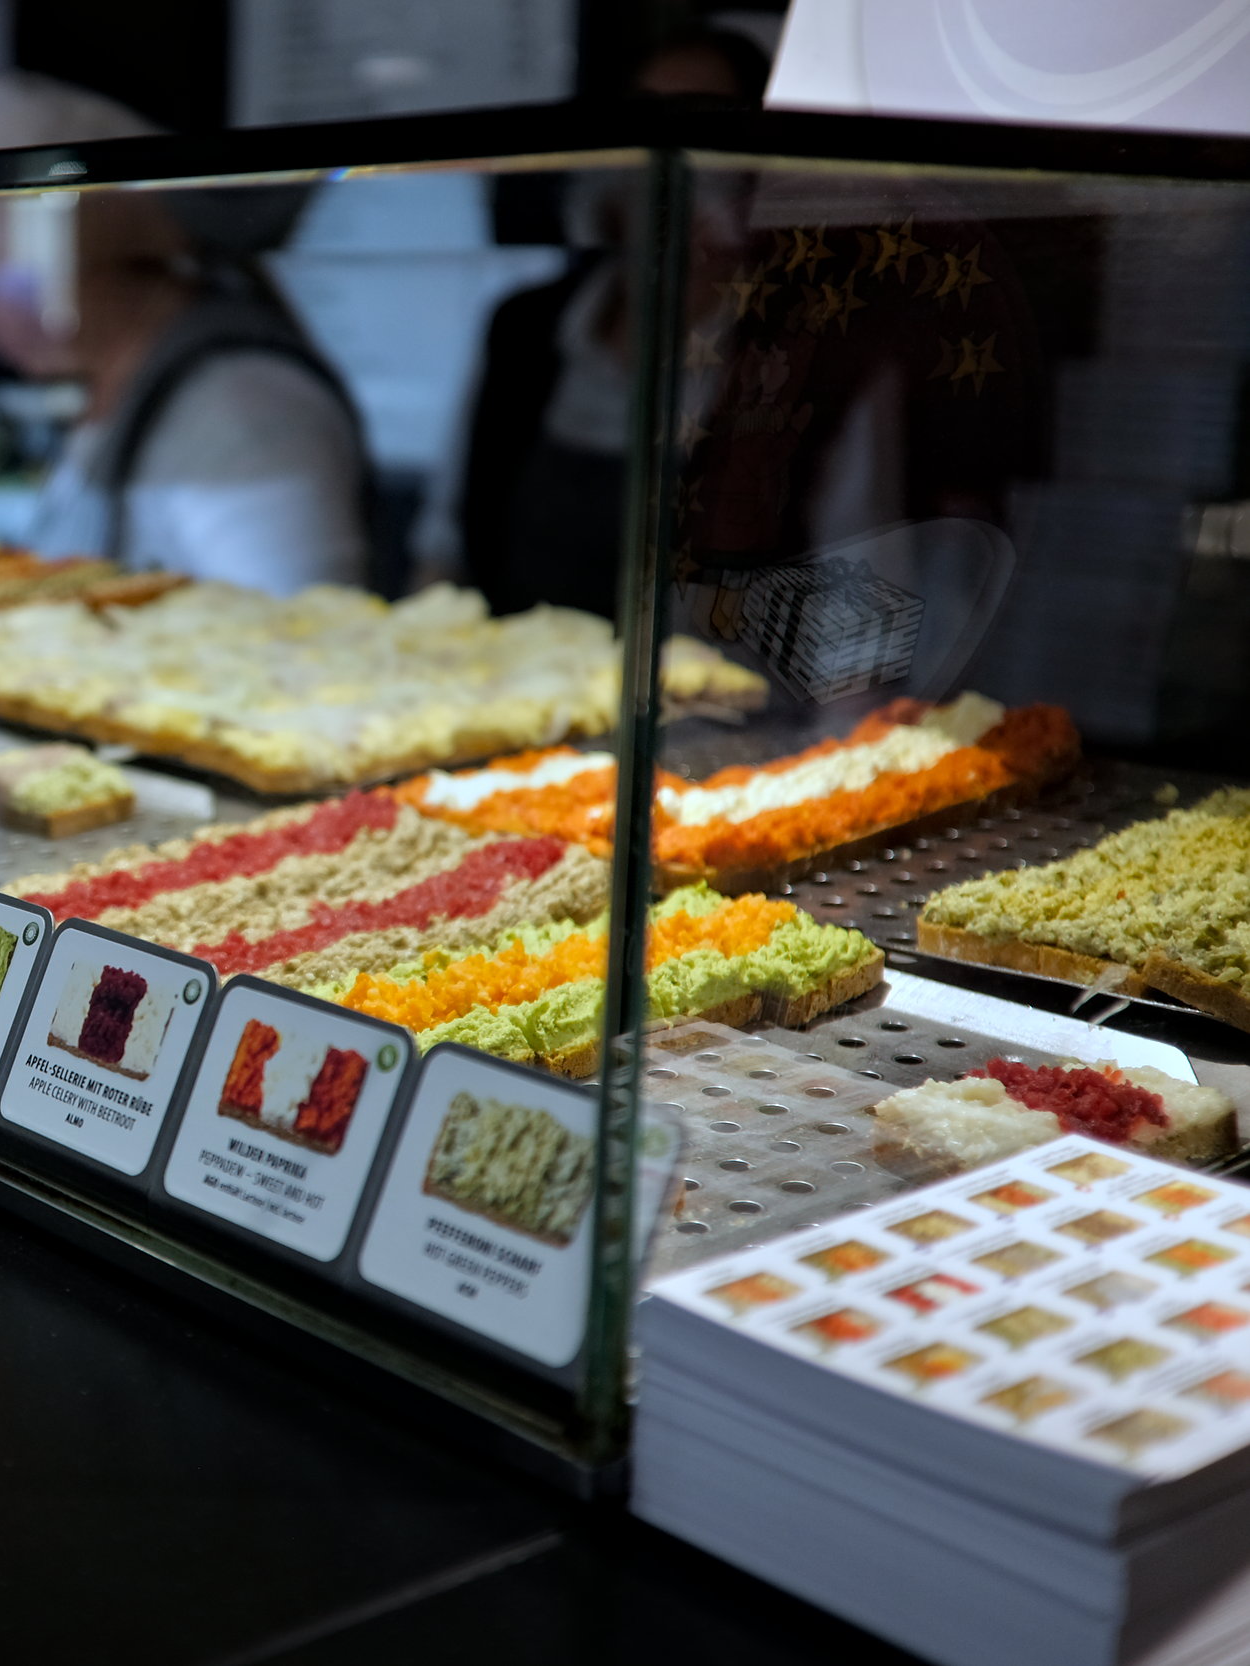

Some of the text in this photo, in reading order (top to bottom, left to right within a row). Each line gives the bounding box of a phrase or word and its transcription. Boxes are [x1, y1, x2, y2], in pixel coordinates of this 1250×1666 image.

[26, 1054, 154, 1116] APFEL-SELLERIE MIT ROTER RÜBE
[29, 1076, 136, 1131] APPLE CELERY WITH BEETROOT
[66, 1113, 84, 1128] ALMO
[228, 1138, 308, 1180] WILDER PAPRIKA
[252, 1172, 284, 1194] SWEET
[284, 1184, 306, 1202] AND
[305, 1192, 326, 1210] HOT
